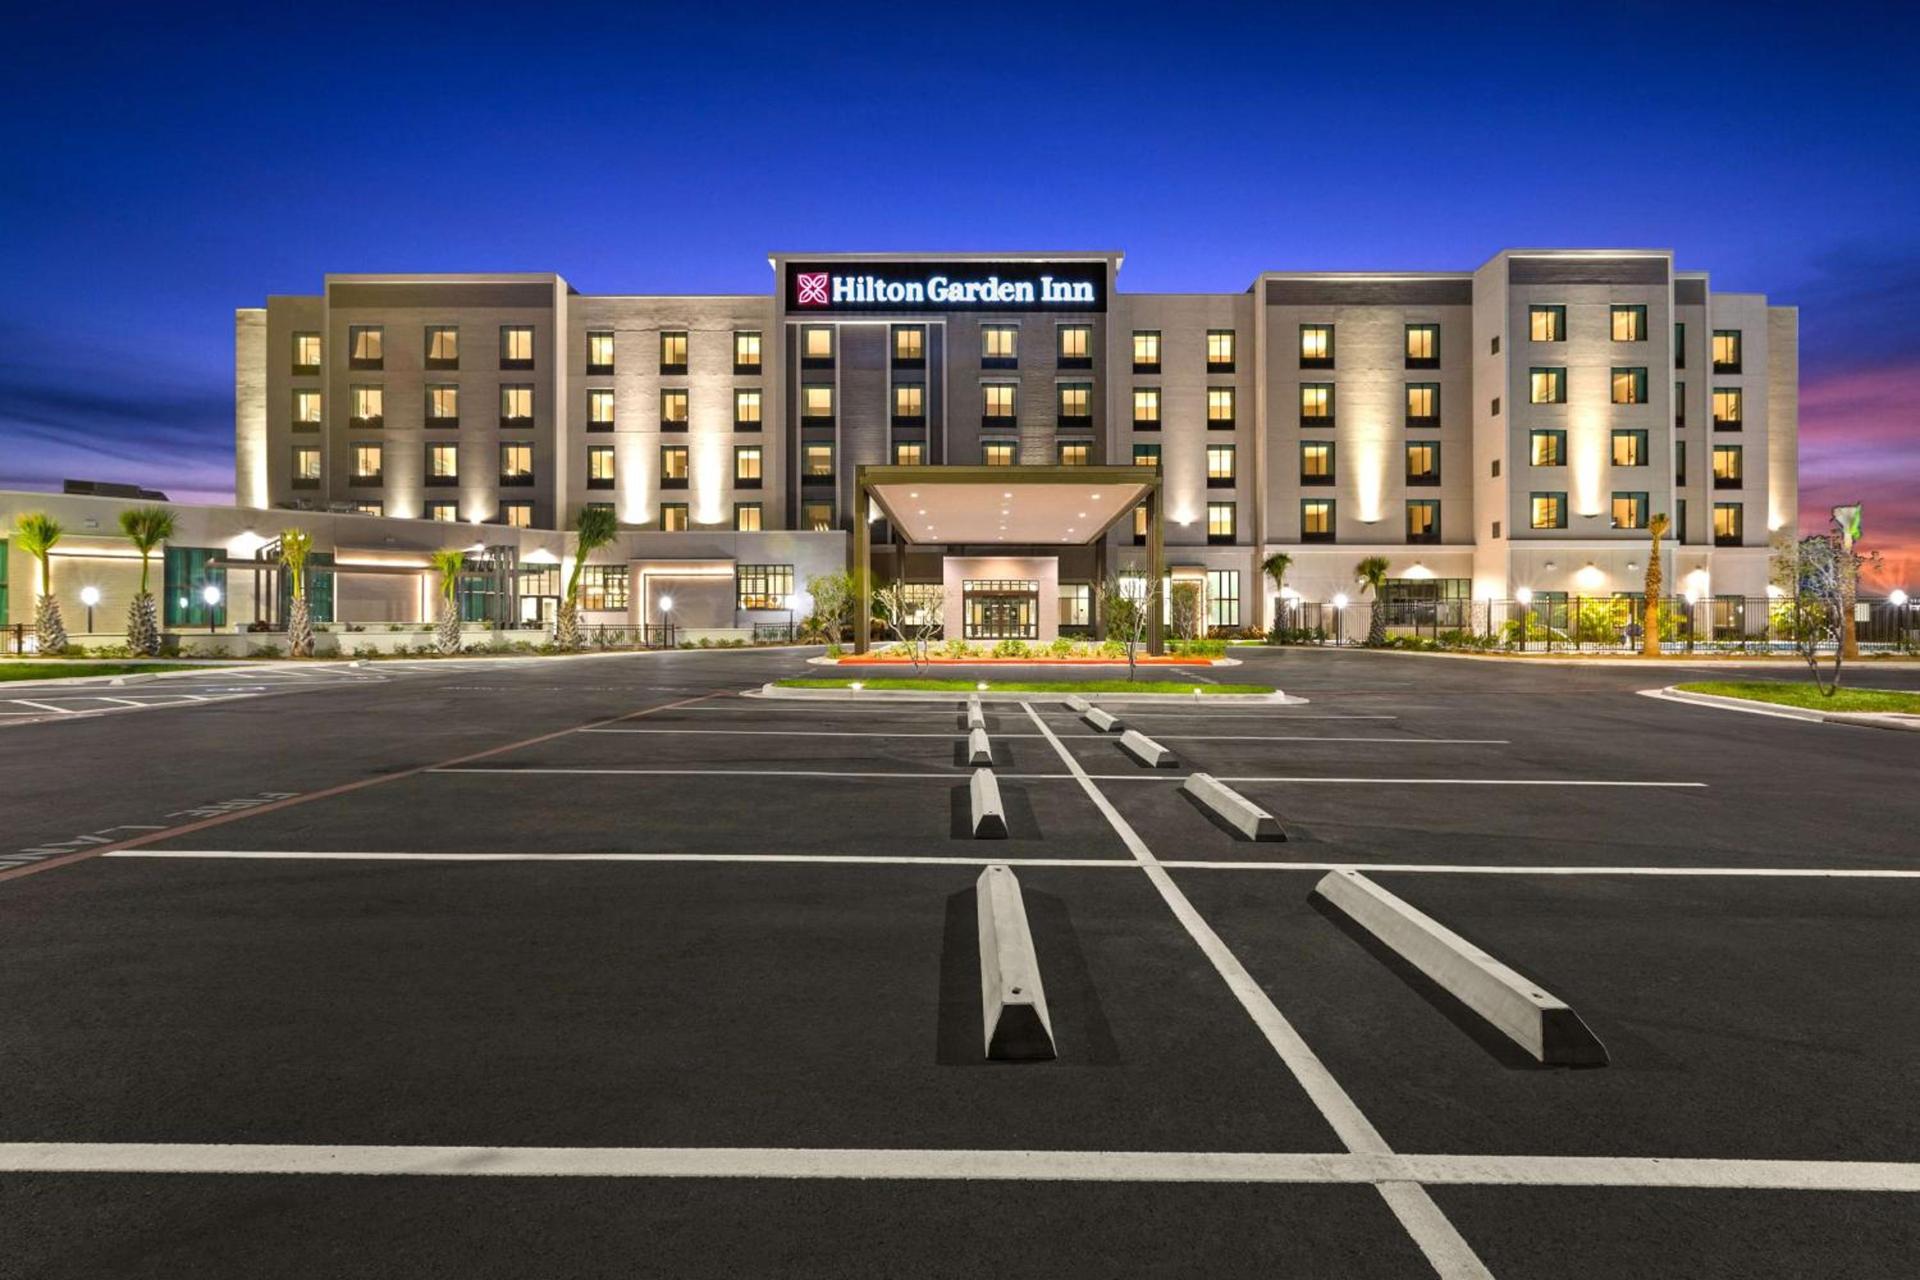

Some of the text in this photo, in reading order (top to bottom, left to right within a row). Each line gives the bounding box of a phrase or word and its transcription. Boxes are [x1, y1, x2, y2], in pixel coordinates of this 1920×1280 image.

[832, 276, 1095, 302] Hilton Garden Inn
